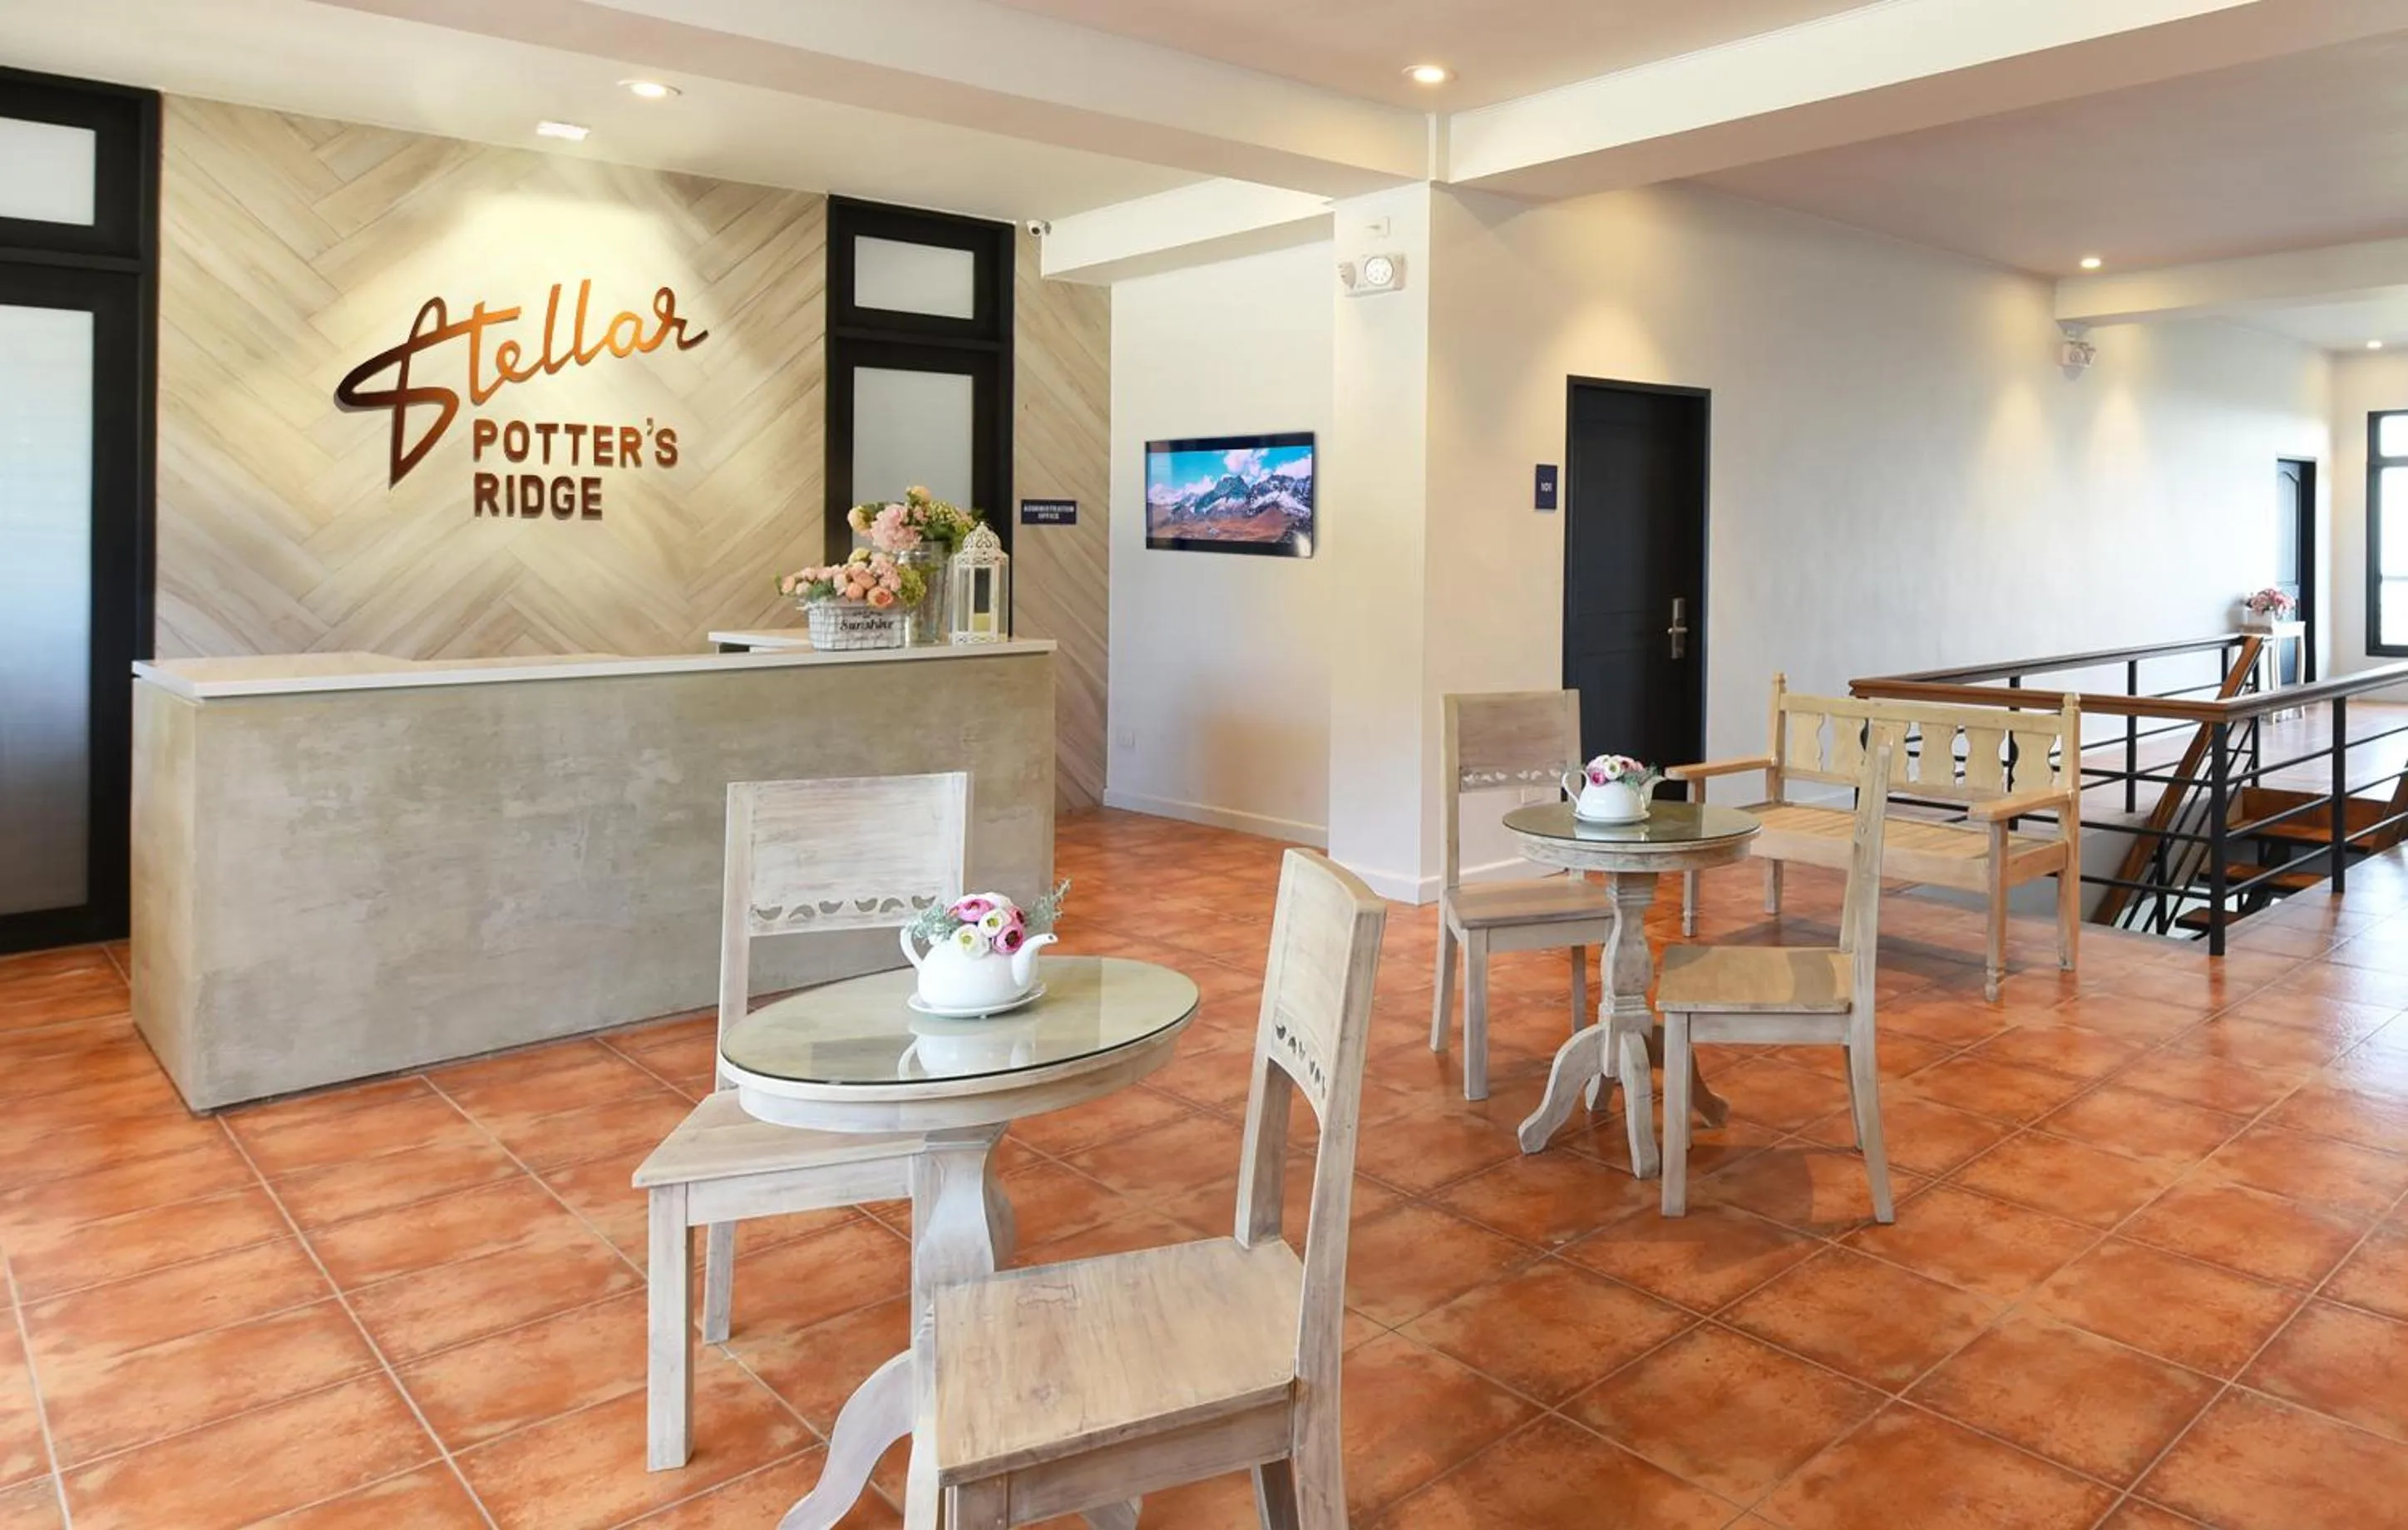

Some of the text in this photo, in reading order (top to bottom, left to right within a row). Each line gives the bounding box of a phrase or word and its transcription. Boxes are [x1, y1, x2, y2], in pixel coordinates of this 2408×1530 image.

[335, 279, 709, 491] Stellar
[473, 417, 678, 468] POTTER'S
[473, 471, 603, 521] RIDGE
